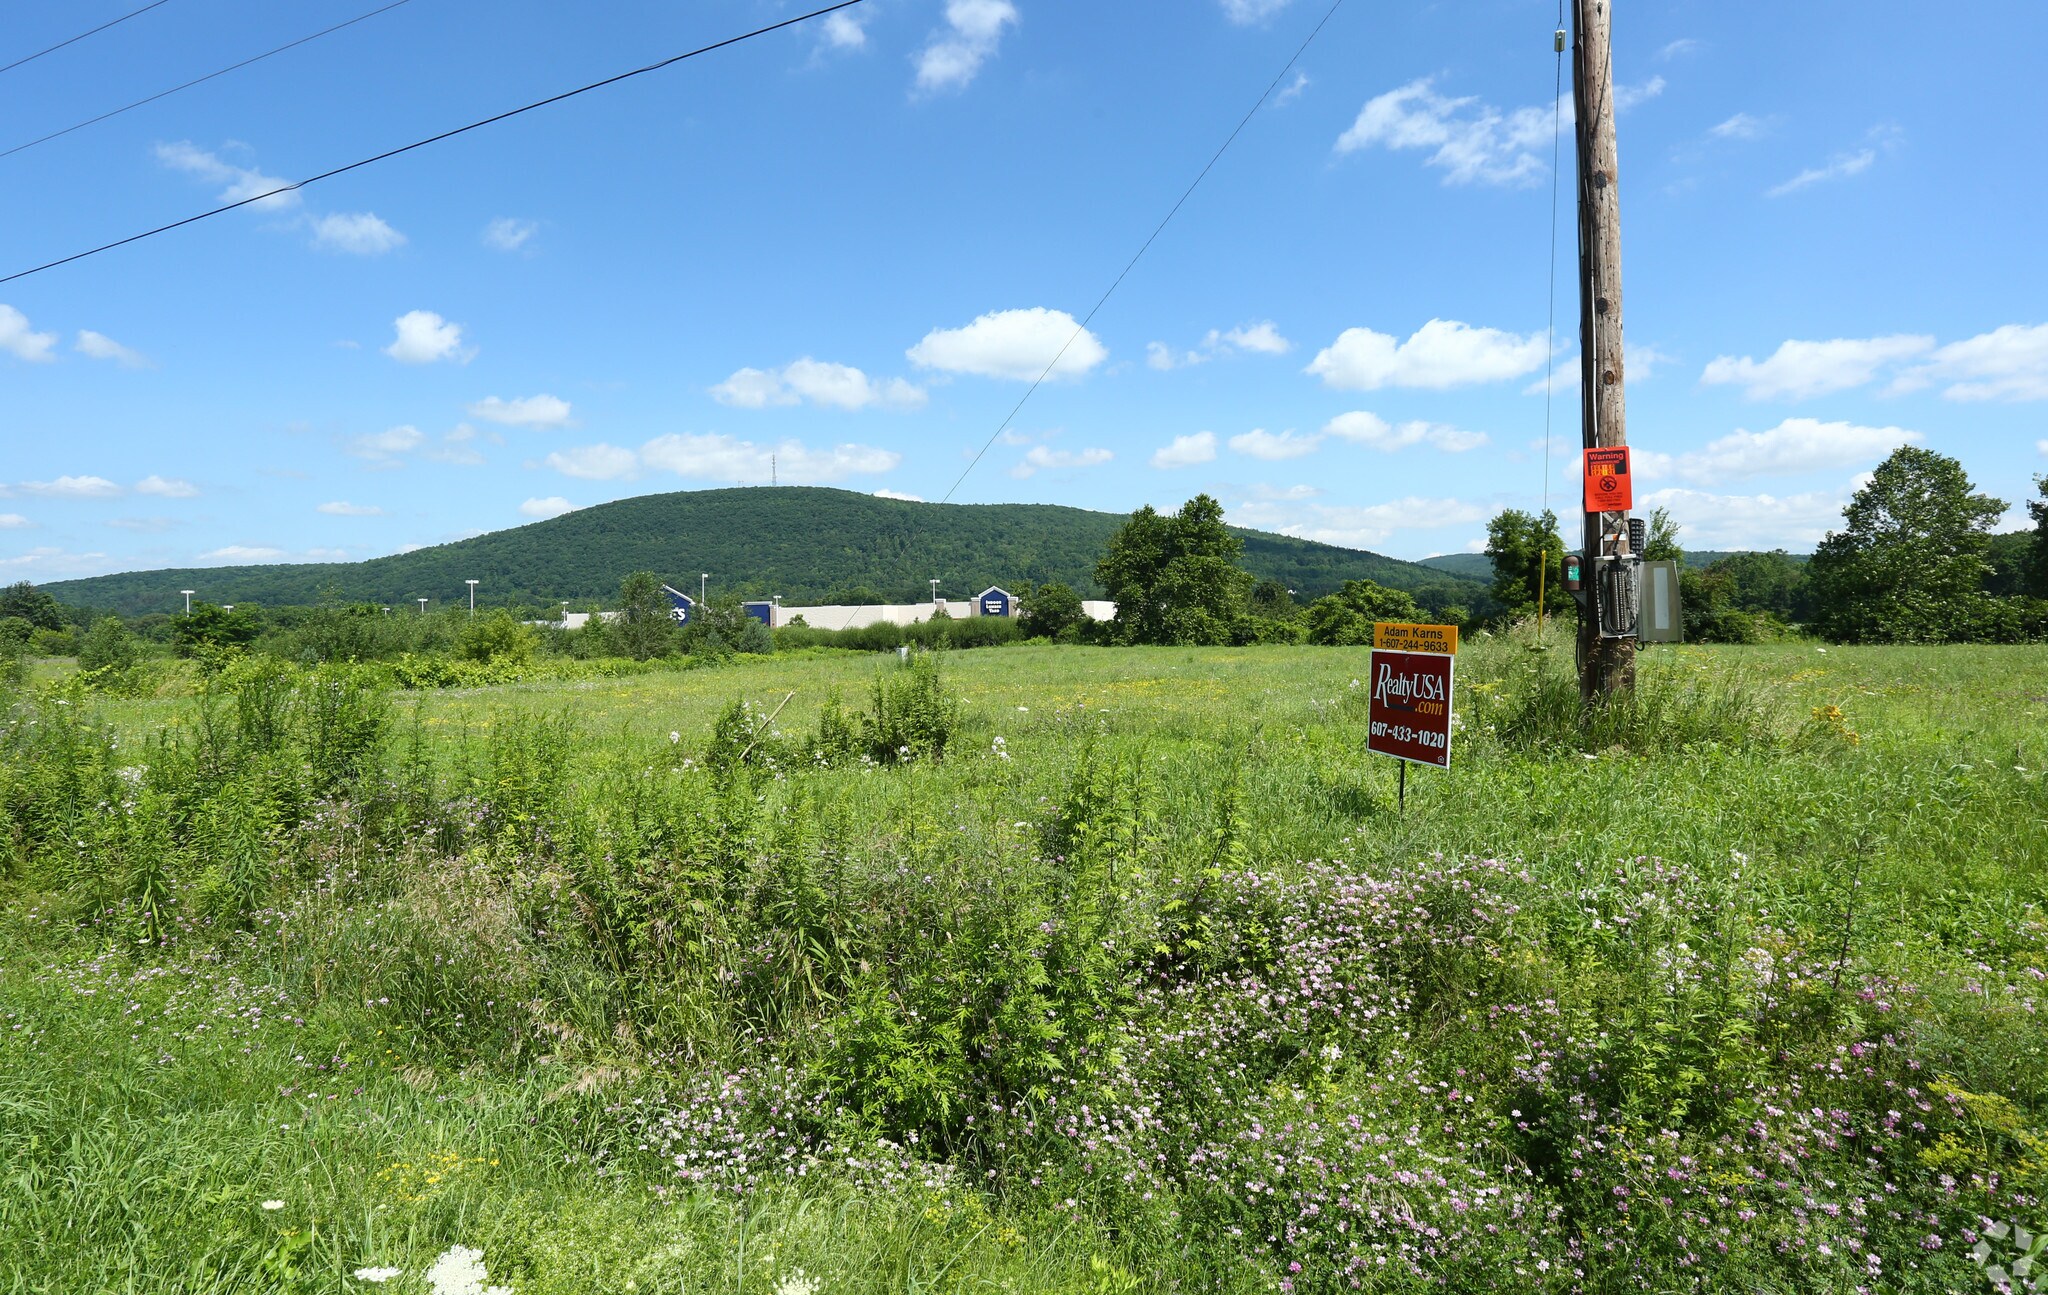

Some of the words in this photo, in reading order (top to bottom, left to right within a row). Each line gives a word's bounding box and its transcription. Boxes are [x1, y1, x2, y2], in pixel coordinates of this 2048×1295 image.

[1384, 626, 1409, 637] Adam
[1412, 627, 1443, 639] Karns
[1380, 638, 1448, 652] 1-607-244-9633
[1373, 663, 1445, 708] RealtyUSA
[1415, 701, 1443, 715] .com
[1371, 721, 1445, 749] 607-433-1020
